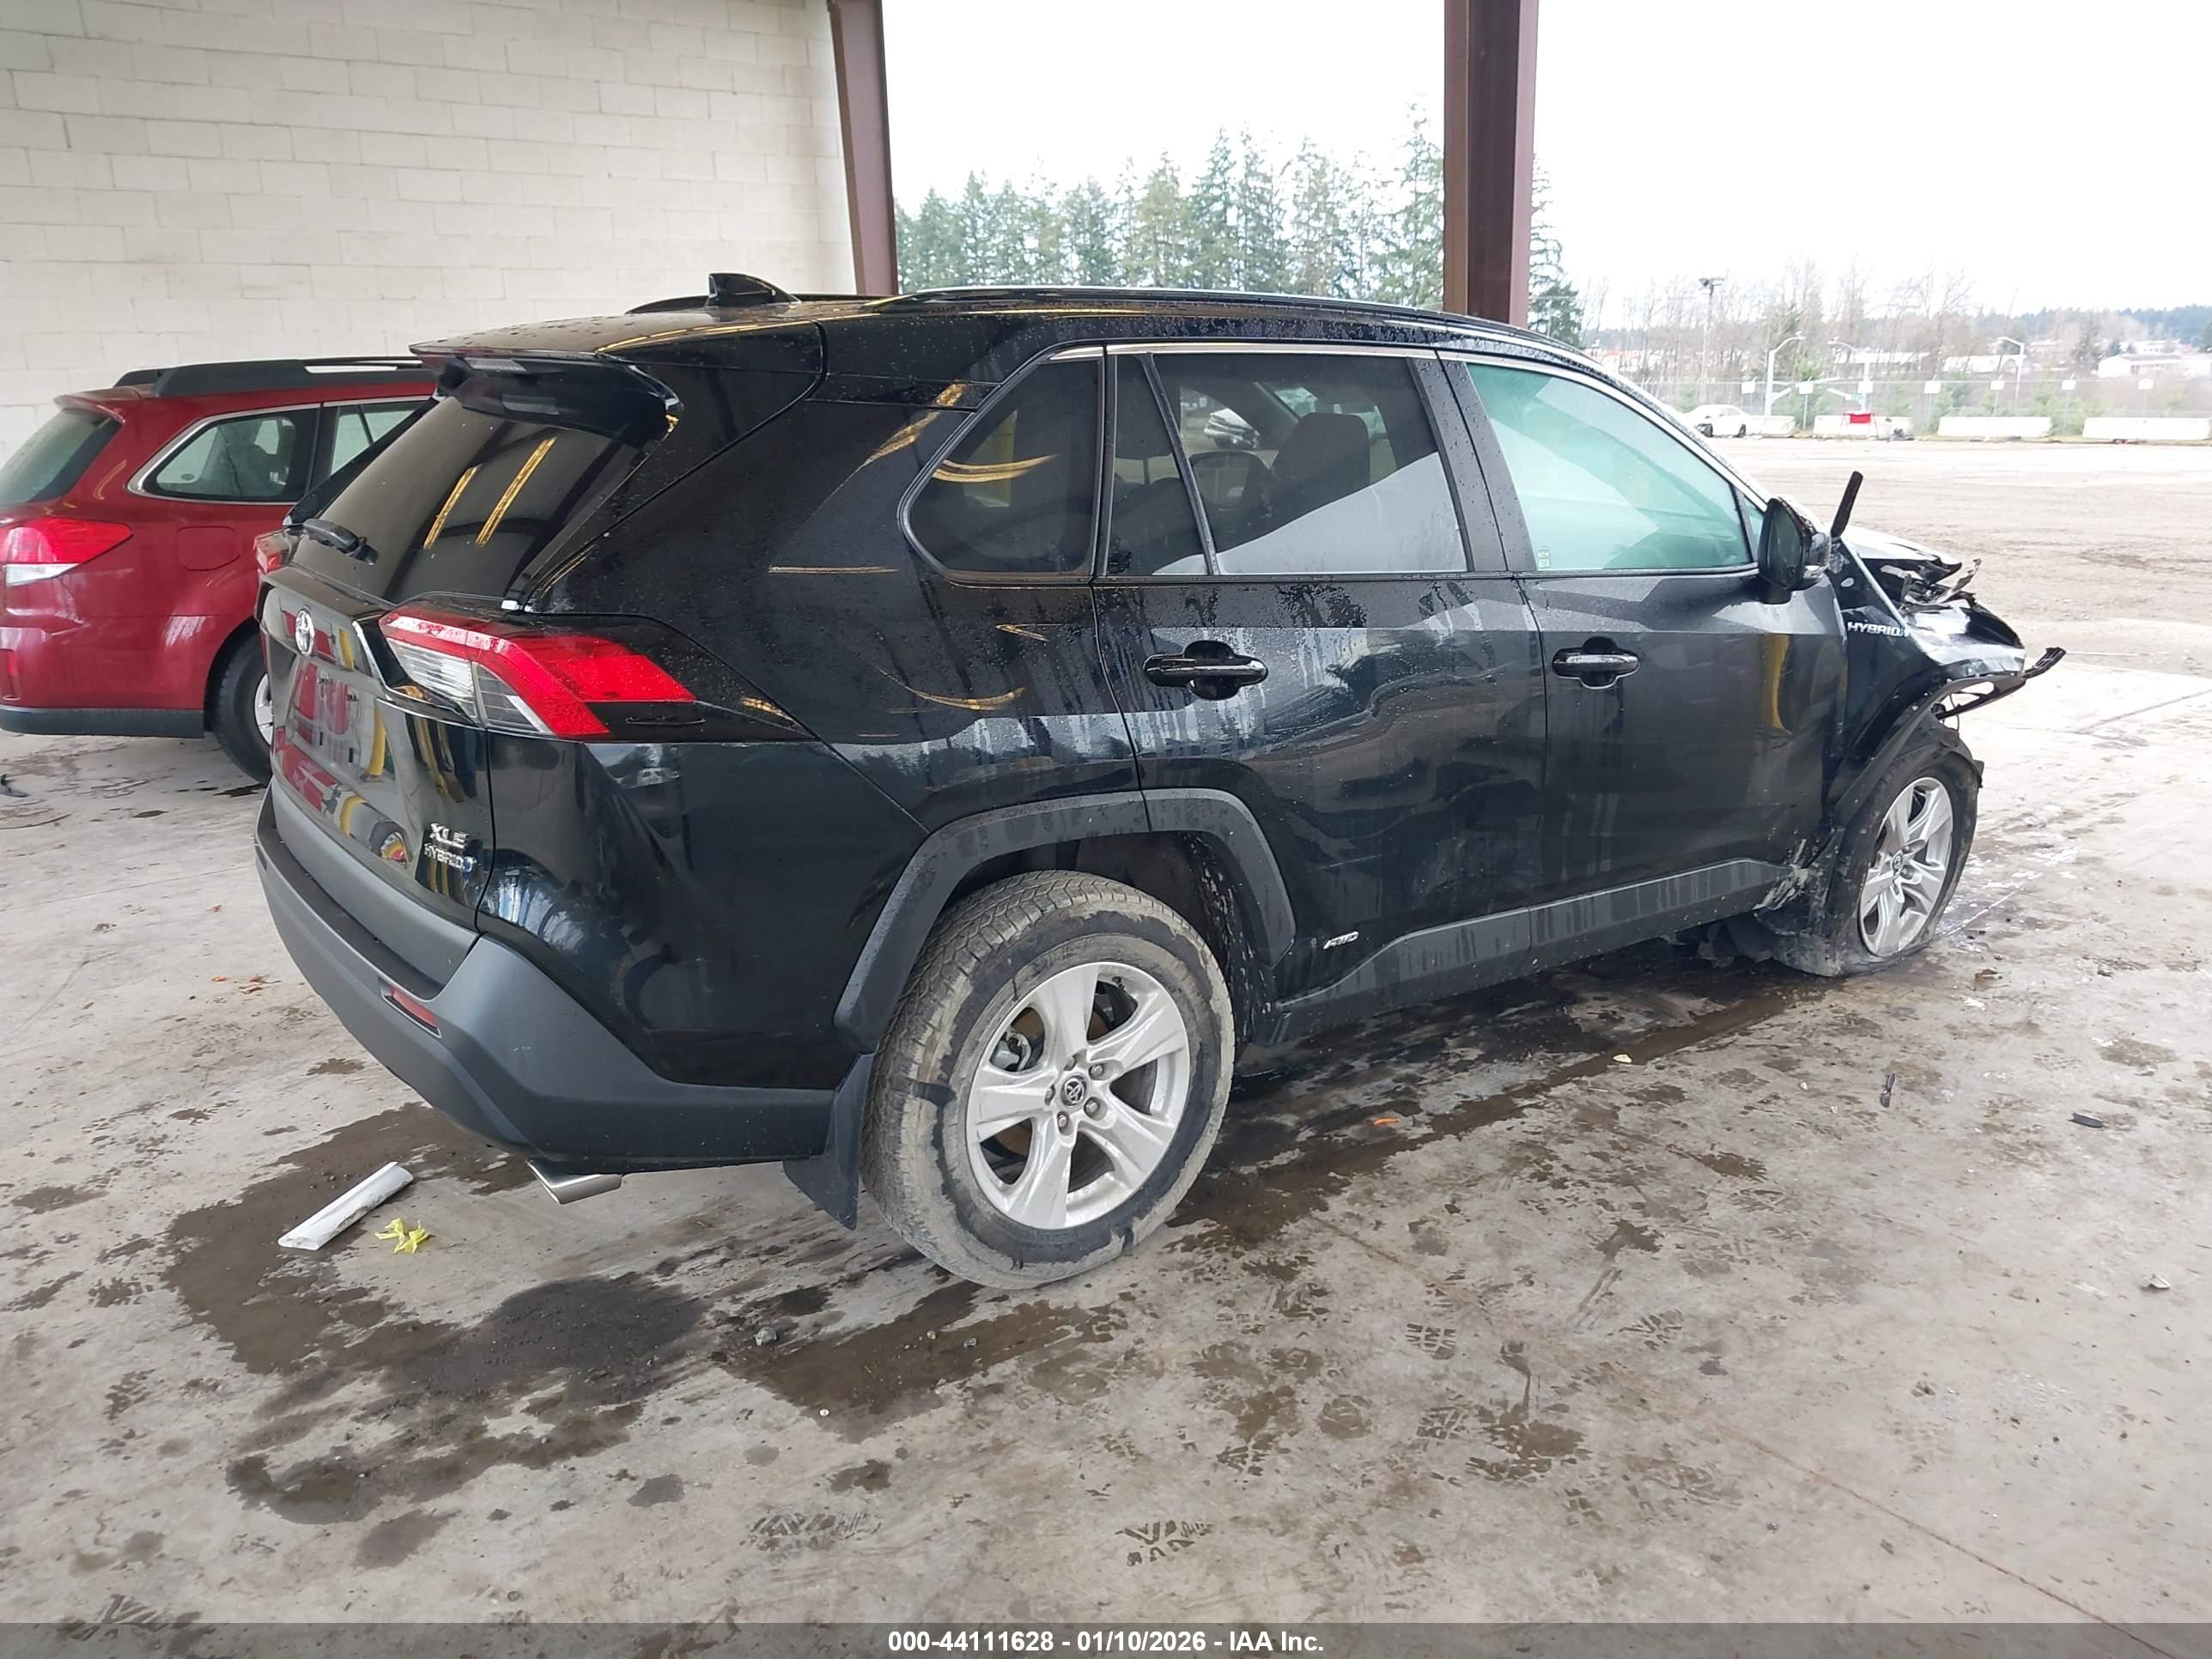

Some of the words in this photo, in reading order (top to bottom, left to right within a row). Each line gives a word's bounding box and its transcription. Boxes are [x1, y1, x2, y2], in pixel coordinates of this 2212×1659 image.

[1847, 621, 1901, 637] HYBRID
[428, 823, 468, 849] XLE
[423, 842, 465, 869] HYBRID
